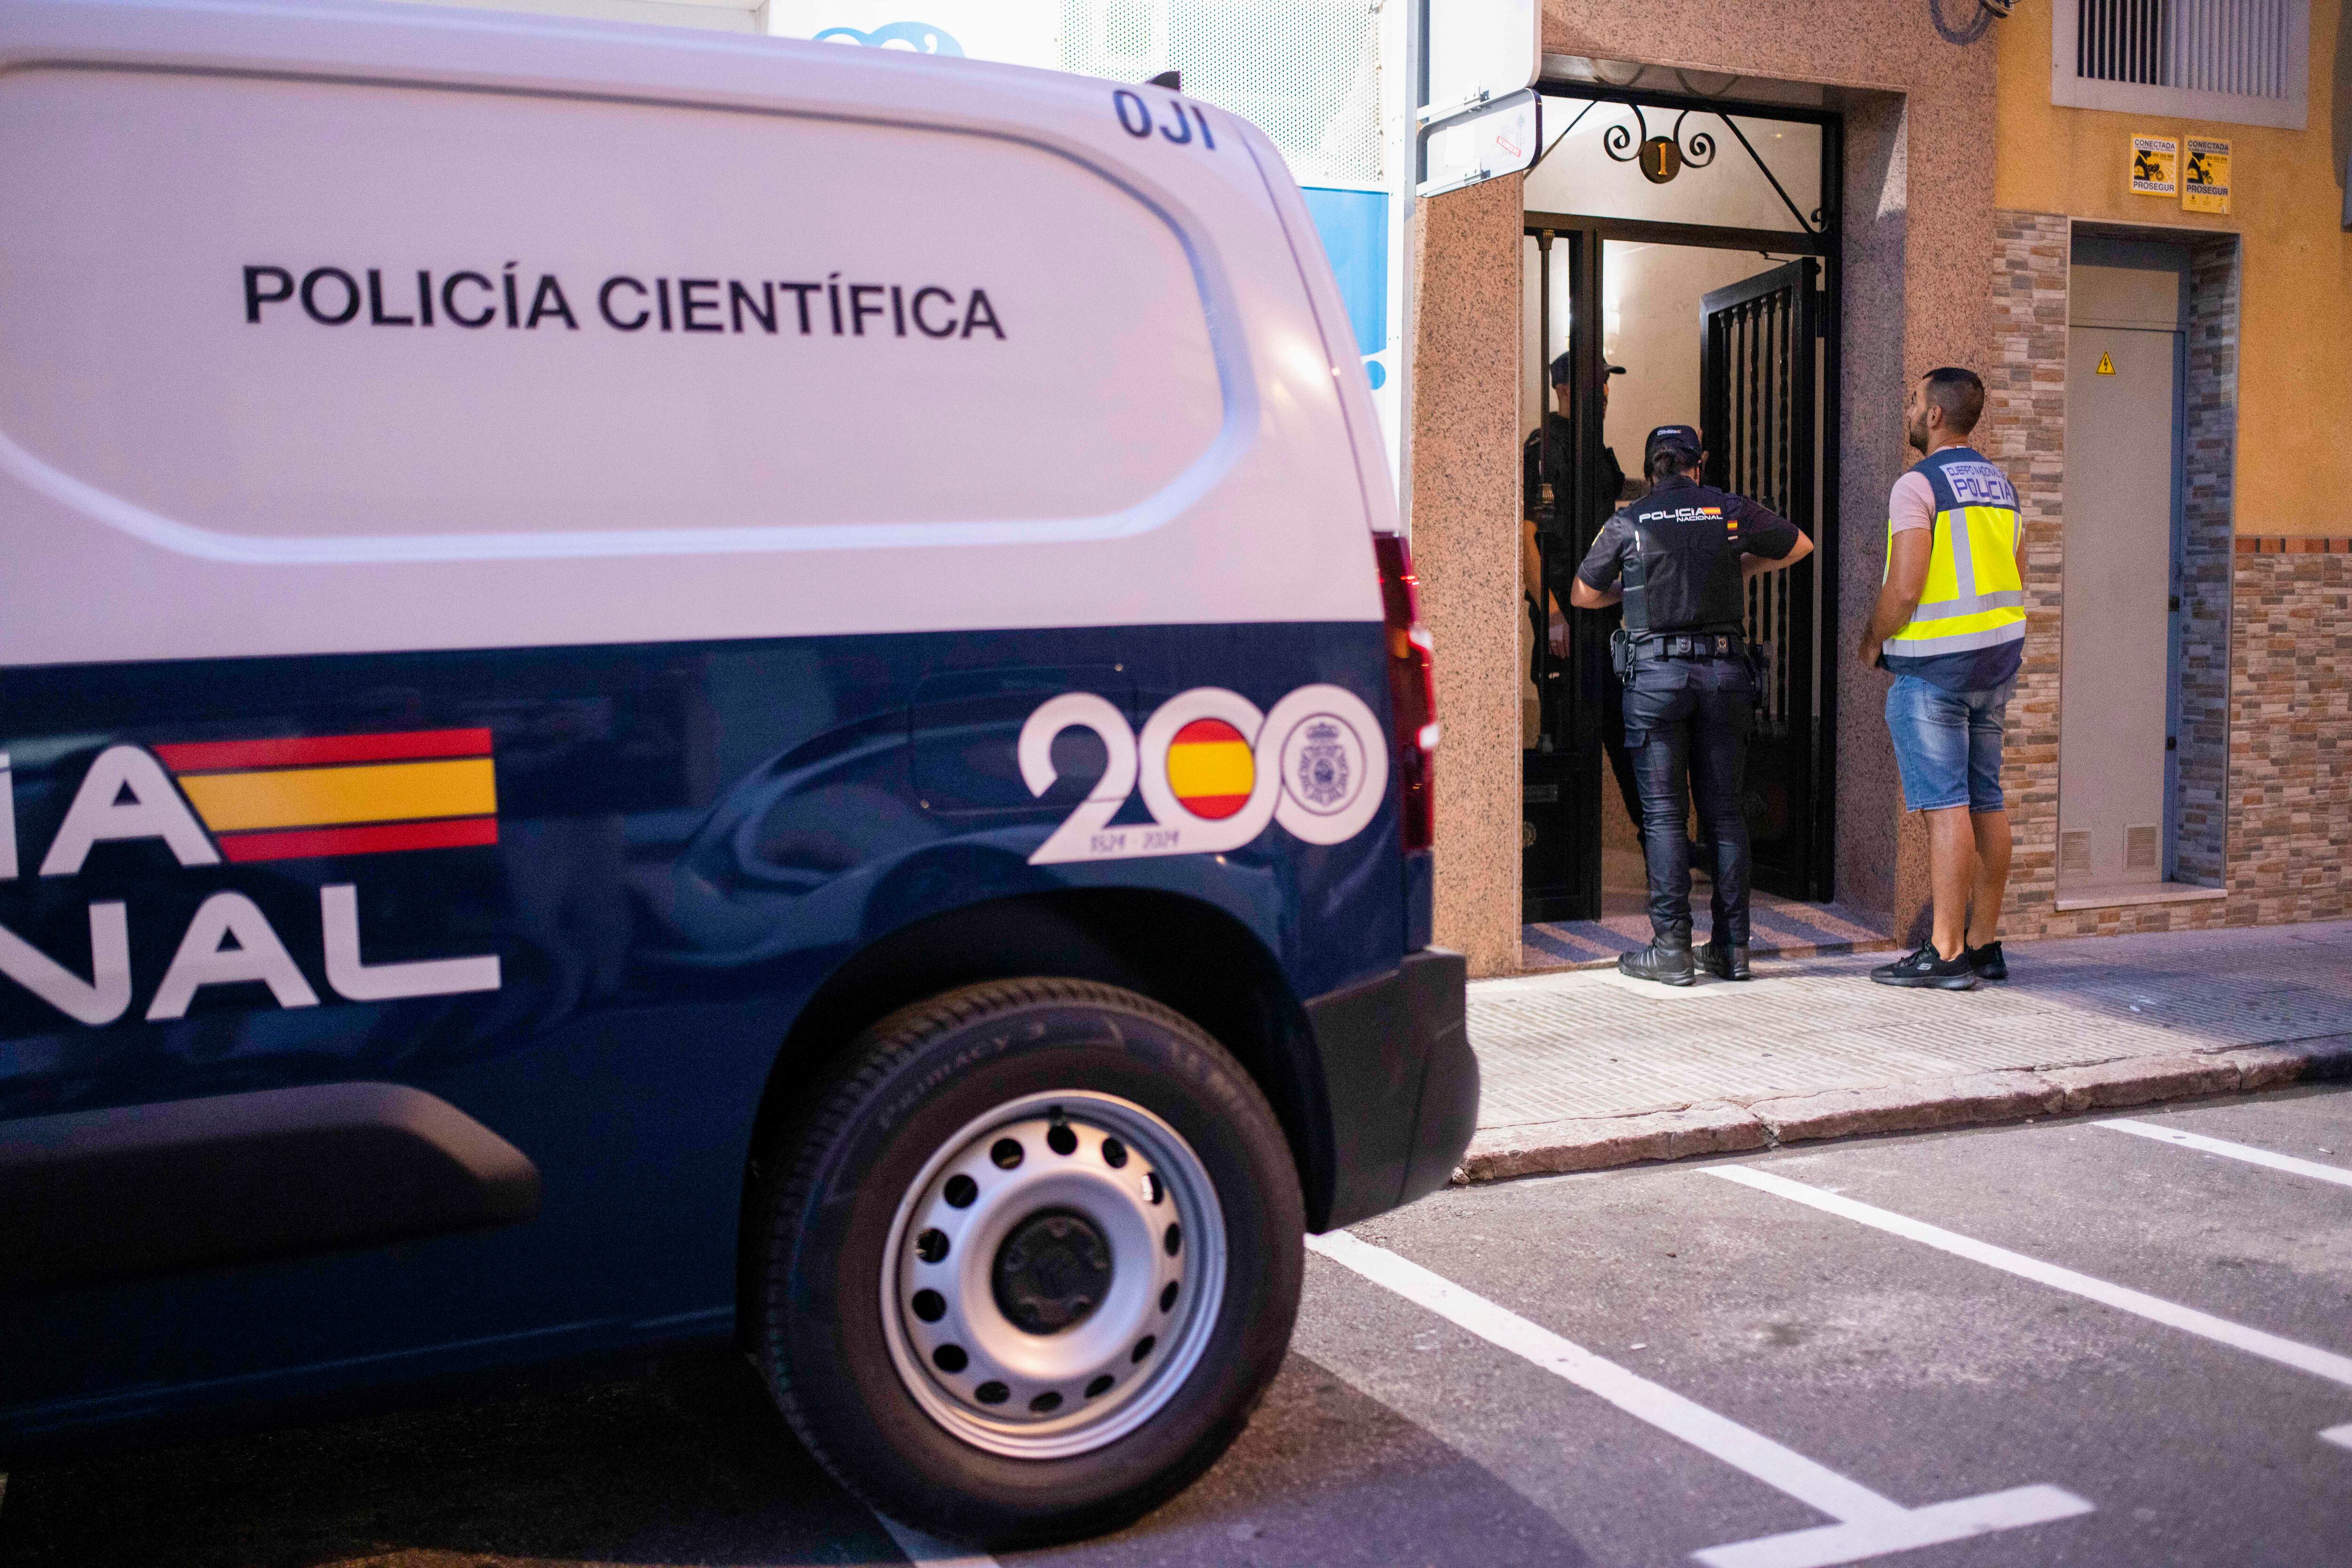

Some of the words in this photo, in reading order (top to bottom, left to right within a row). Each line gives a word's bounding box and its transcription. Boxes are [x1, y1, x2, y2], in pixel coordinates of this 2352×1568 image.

[2135, 139, 2175, 149] CONECTADA
[2188, 141, 2228, 150] CONECTADA
[1658, 143, 1668, 175] 1
[2133, 181, 2174, 191] PROSEGUR
[2187, 185, 2228, 196] PROSEGUR
[242, 261, 580, 330] POLICÍA
[597, 272, 1007, 341] CIENTÍFICA
[1947, 466, 1975, 476] CUERPO
[1953, 478, 2013, 501] POLICIA
[1017, 683, 1389, 865] 200
